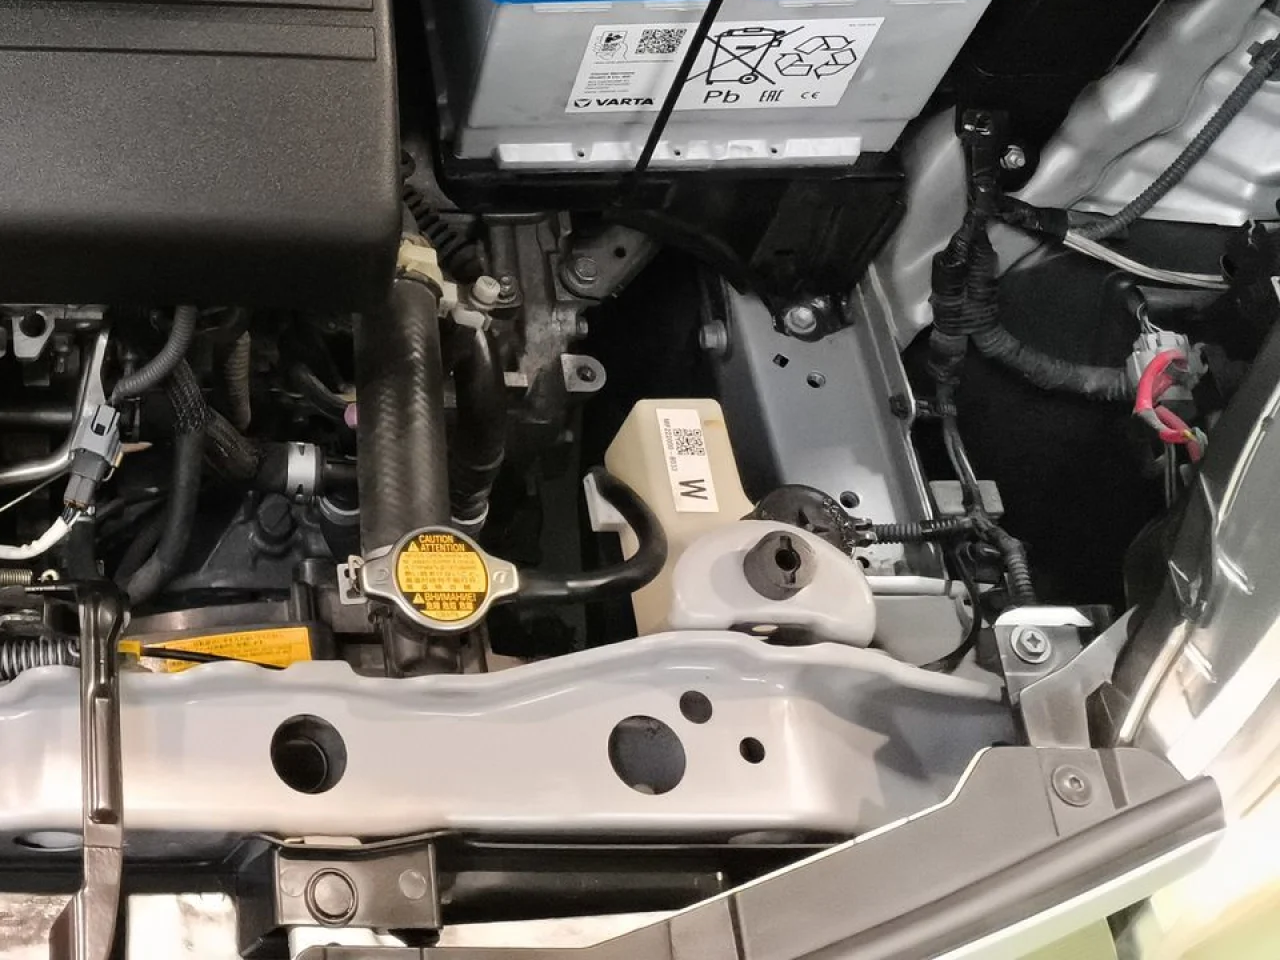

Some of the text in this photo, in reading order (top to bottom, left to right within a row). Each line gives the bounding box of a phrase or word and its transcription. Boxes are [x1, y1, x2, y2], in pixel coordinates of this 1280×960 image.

[703, 89, 741, 104] Pb
[596, 98, 655, 107] VARTA
[419, 535, 454, 544] CAUTION
[421, 543, 465, 552] ATTENTION
